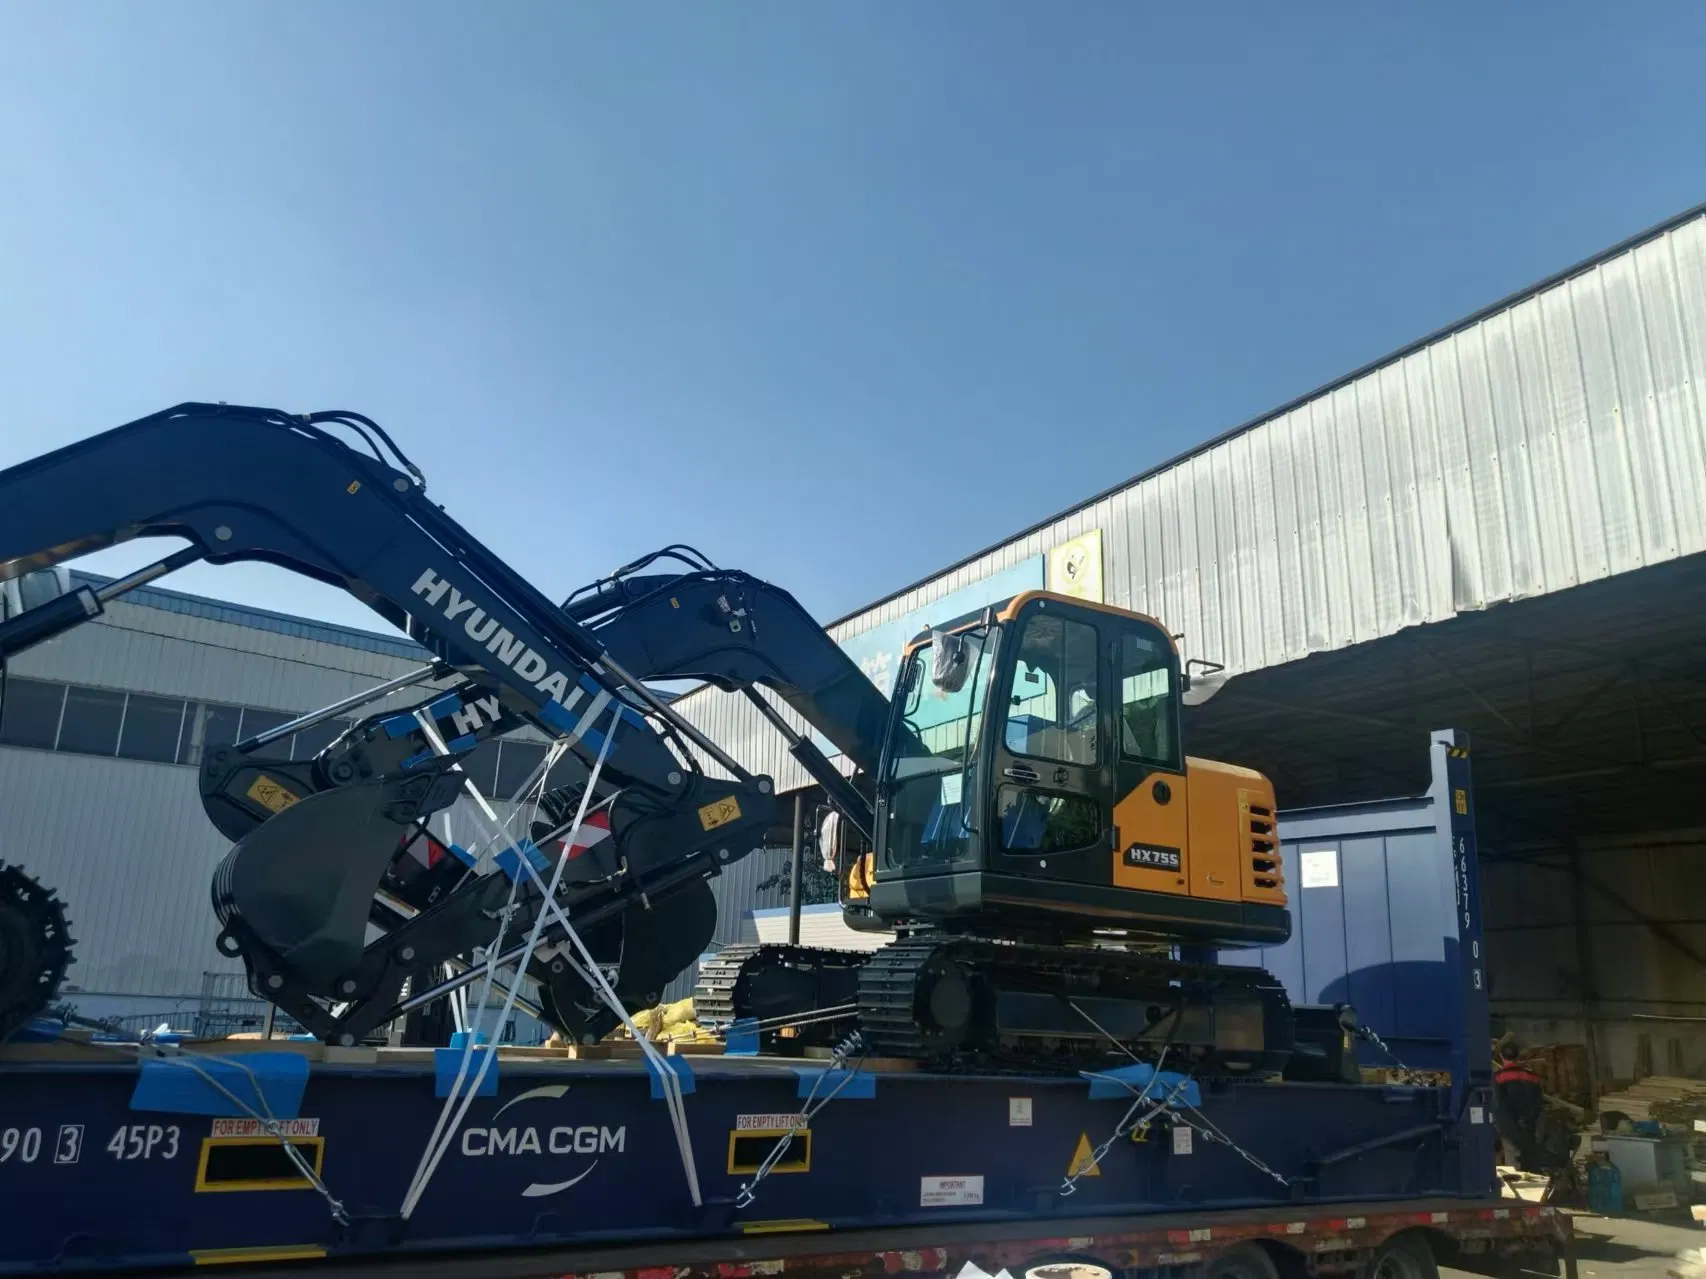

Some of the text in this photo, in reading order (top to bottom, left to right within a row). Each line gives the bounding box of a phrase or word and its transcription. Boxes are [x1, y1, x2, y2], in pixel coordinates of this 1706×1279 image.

[411, 568, 584, 711] HYUNDAI
[1131, 848, 1178, 865] HX75S
[214, 1121, 235, 1134] FOR
[292, 1119, 318, 1134] ONLY
[738, 1116, 751, 1128] FOR
[752, 1116, 775, 1128] EMPTY
[776, 1115, 789, 1128] LIFT
[59, 1126, 79, 1161] 3
[107, 1125, 181, 1159] 45P3
[462, 1126, 626, 1156] CMA CGM
